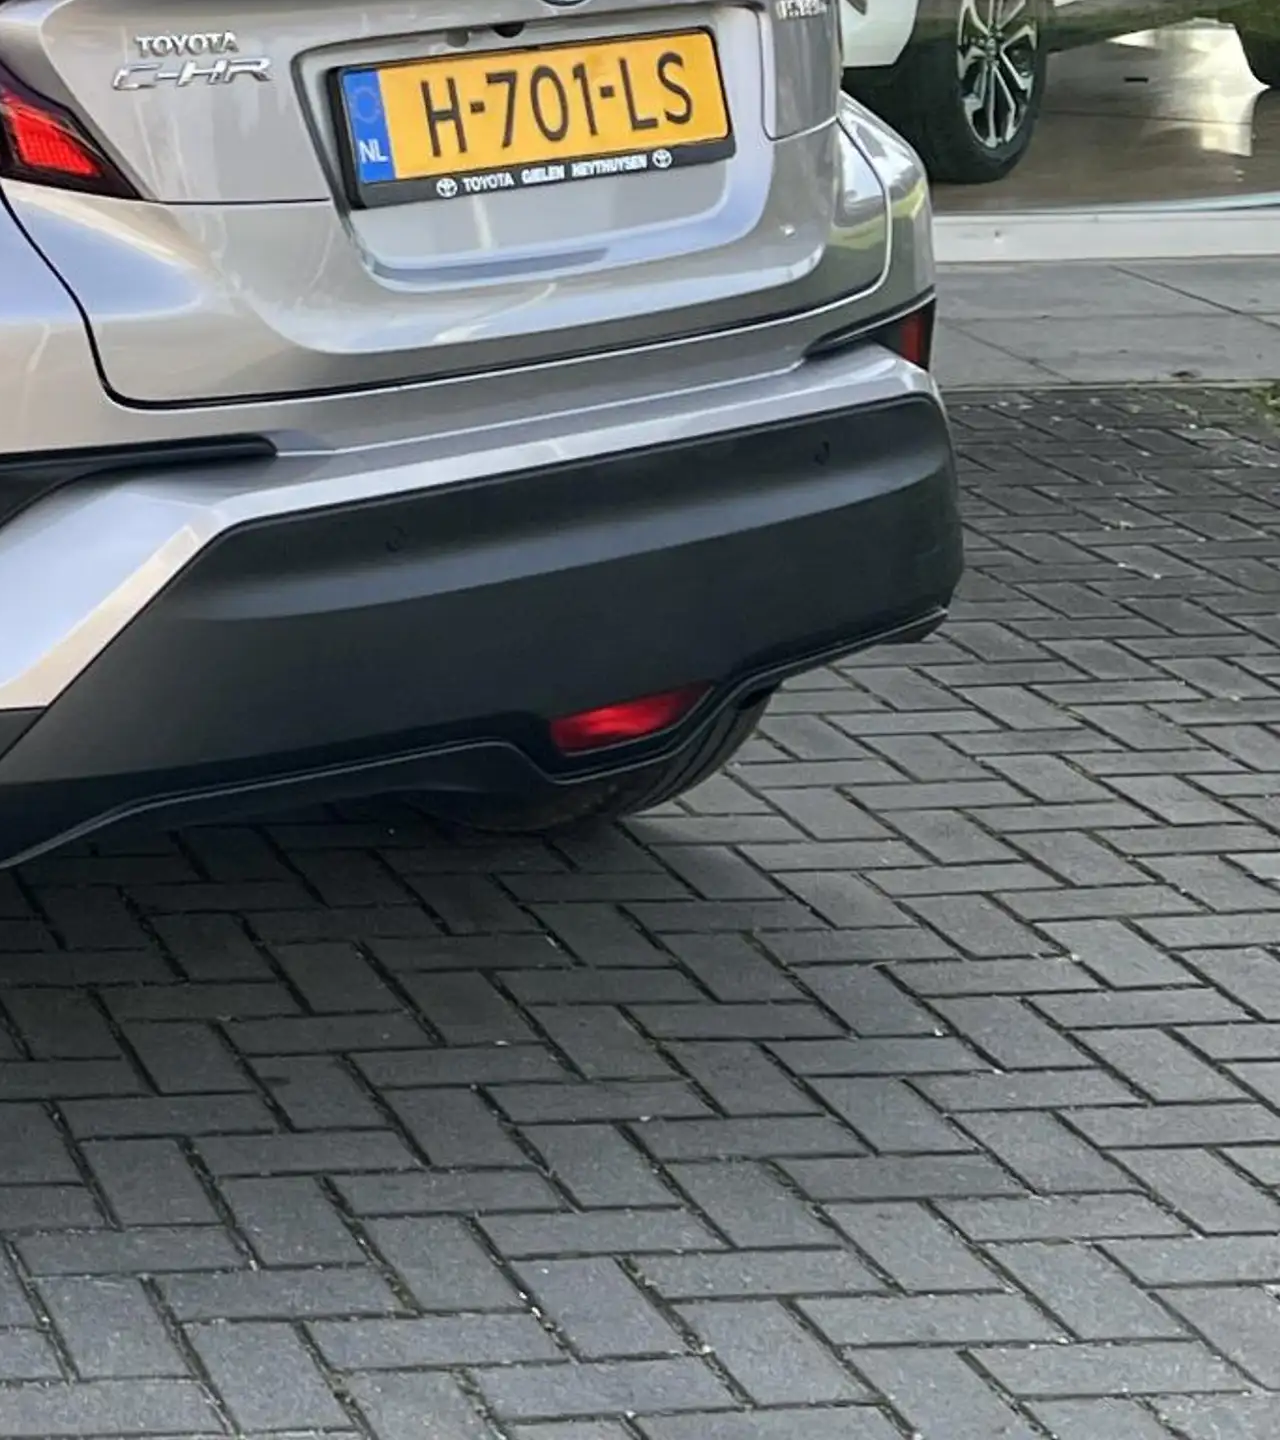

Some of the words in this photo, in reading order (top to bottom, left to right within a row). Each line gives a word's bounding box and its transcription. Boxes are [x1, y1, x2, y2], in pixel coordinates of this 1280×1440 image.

[134, 31, 240, 58] TOYOTA
[111, 58, 272, 91] C-HR
[420, 51, 694, 158] H-701-LS
[359, 139, 389, 164] NL
[462, 171, 514, 193] TOYOTA
